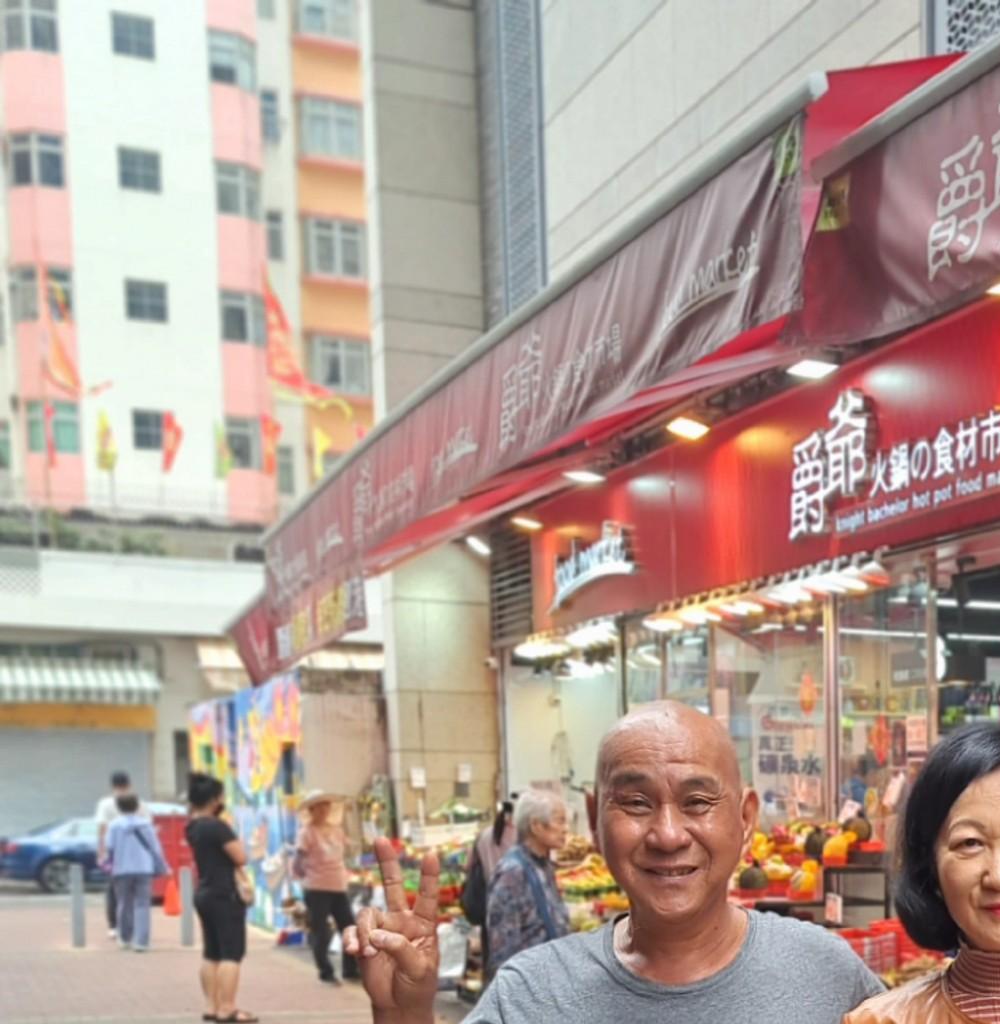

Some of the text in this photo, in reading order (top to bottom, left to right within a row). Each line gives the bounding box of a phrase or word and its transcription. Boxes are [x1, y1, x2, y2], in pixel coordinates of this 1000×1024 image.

[789, 389, 867, 540] 爵爺
[912, 490, 930, 509] hot
[934, 484, 952, 508] pot
[956, 475, 982, 496] food
